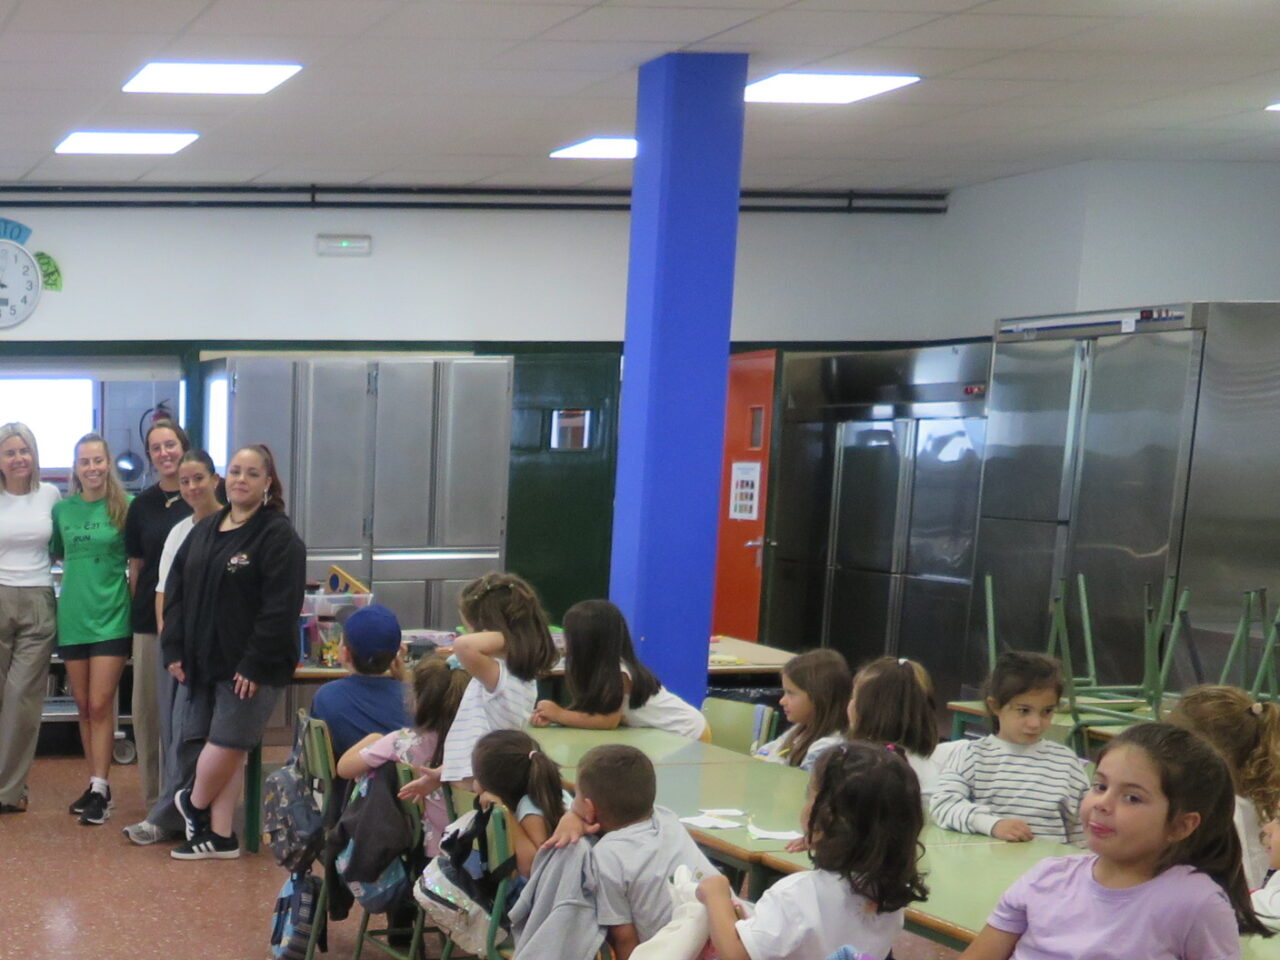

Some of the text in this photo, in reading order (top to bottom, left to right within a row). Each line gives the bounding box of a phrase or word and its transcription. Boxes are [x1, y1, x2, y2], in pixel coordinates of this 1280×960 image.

[22, 265, 30, 276] 2
[25, 280, 33, 291] 3
[20, 294, 28, 305] 4
[9, 304, 17, 316] 5
